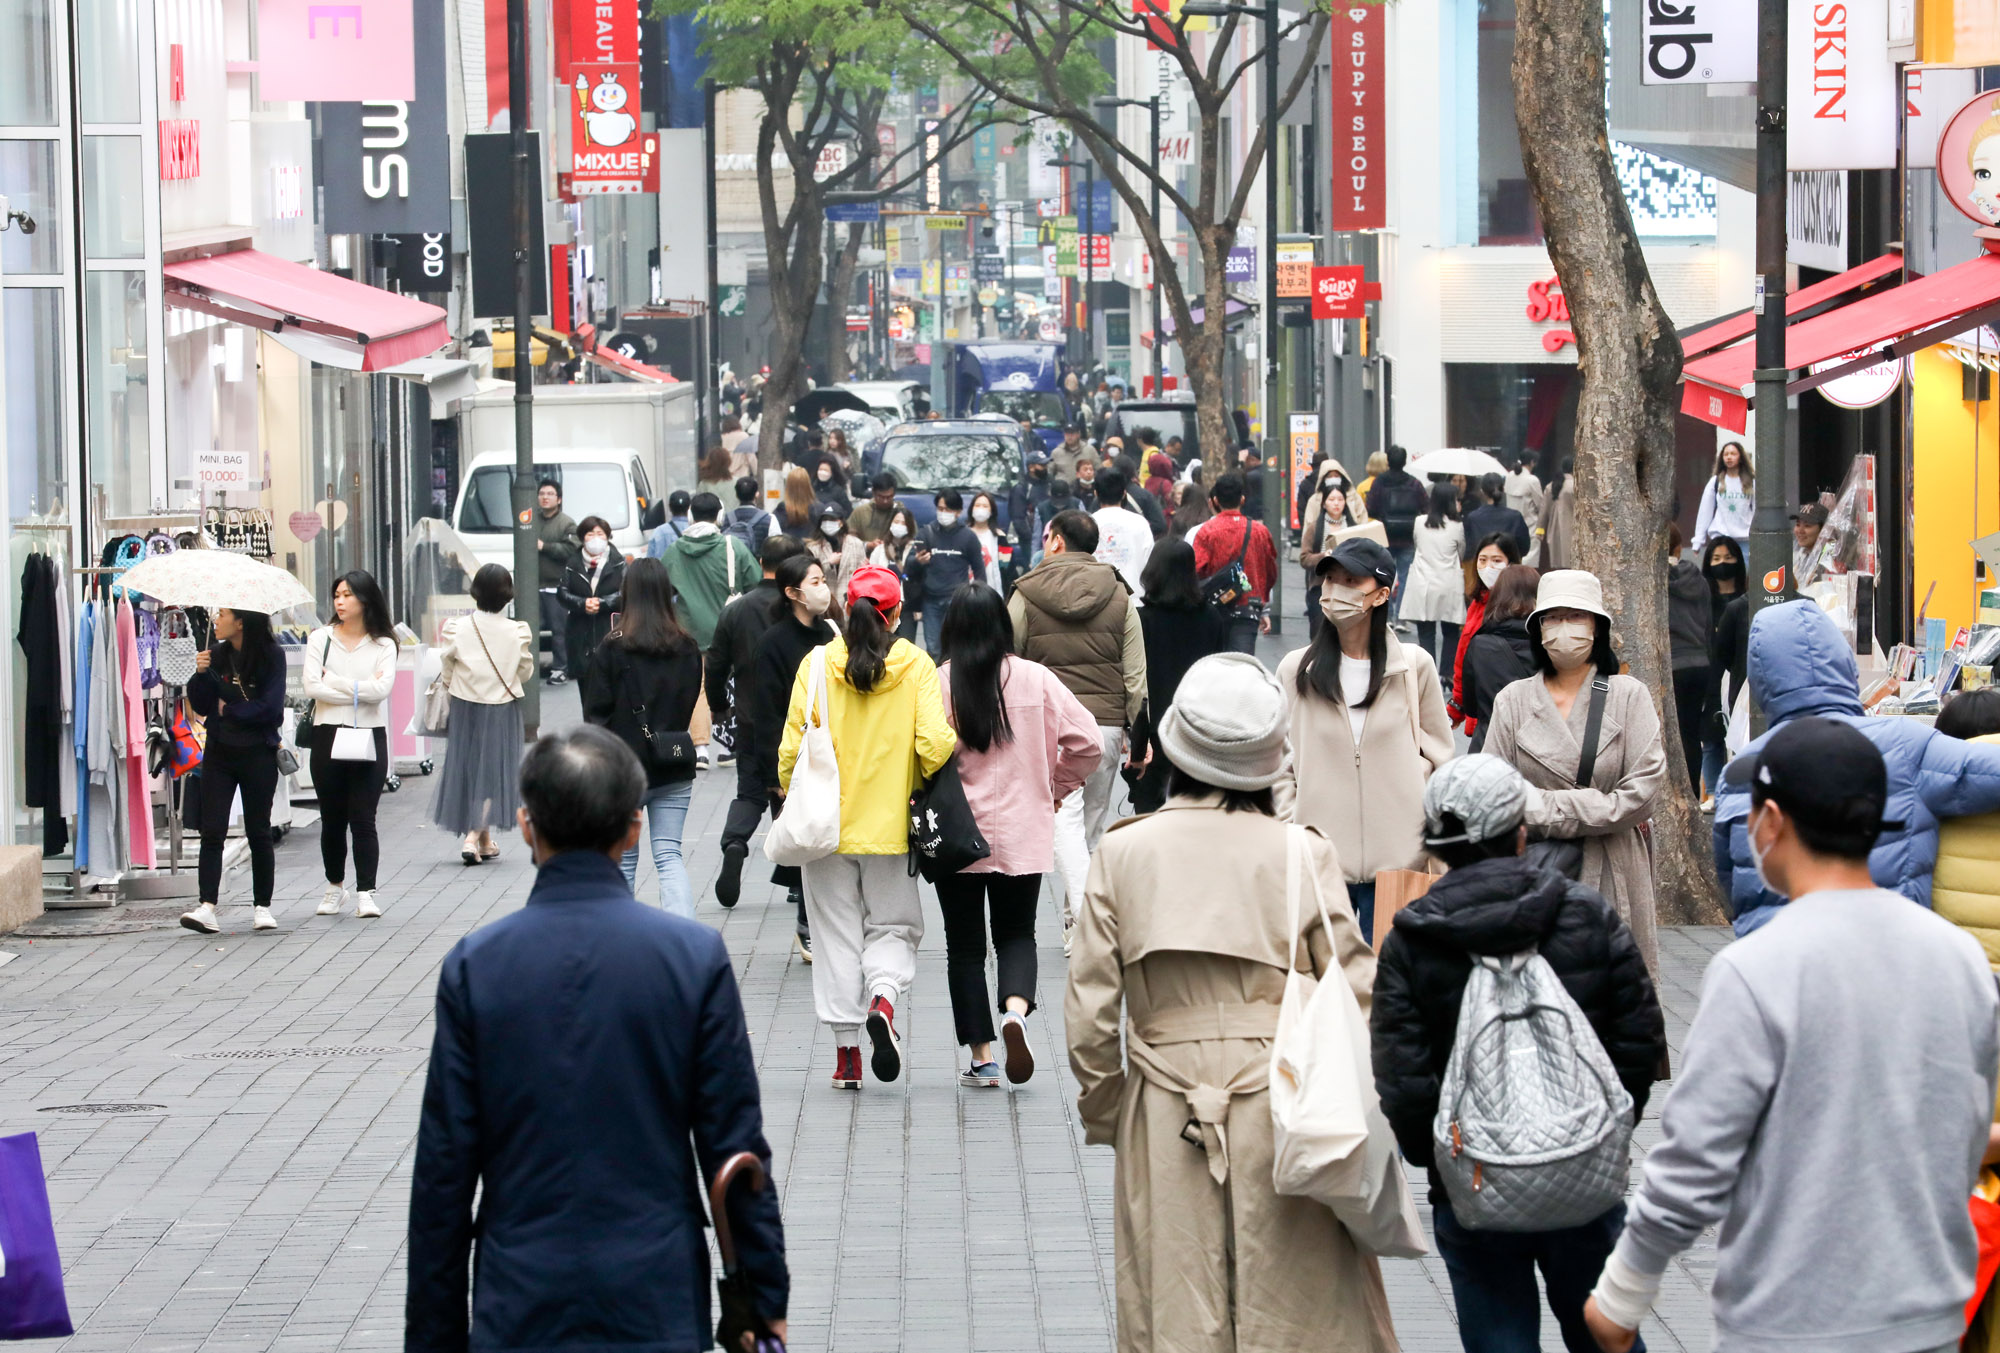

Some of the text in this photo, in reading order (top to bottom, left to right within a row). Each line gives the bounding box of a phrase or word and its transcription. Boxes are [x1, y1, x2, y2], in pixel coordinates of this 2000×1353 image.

[596, 0, 614, 64] EAUT
[1814, 3, 1847, 122] SKIN
[1351, 31, 1367, 211] SUPY SEOUL
[1159, 137, 1190, 160] H&M
[575, 153, 639, 169] MIXUE
[1318, 277, 1357, 303] Supy
[1526, 275, 1572, 323] Su
[223, 455, 243, 465] BAG
[199, 470, 238, 482] 10,000
[1763, 595, 1785, 603] 서울중구
